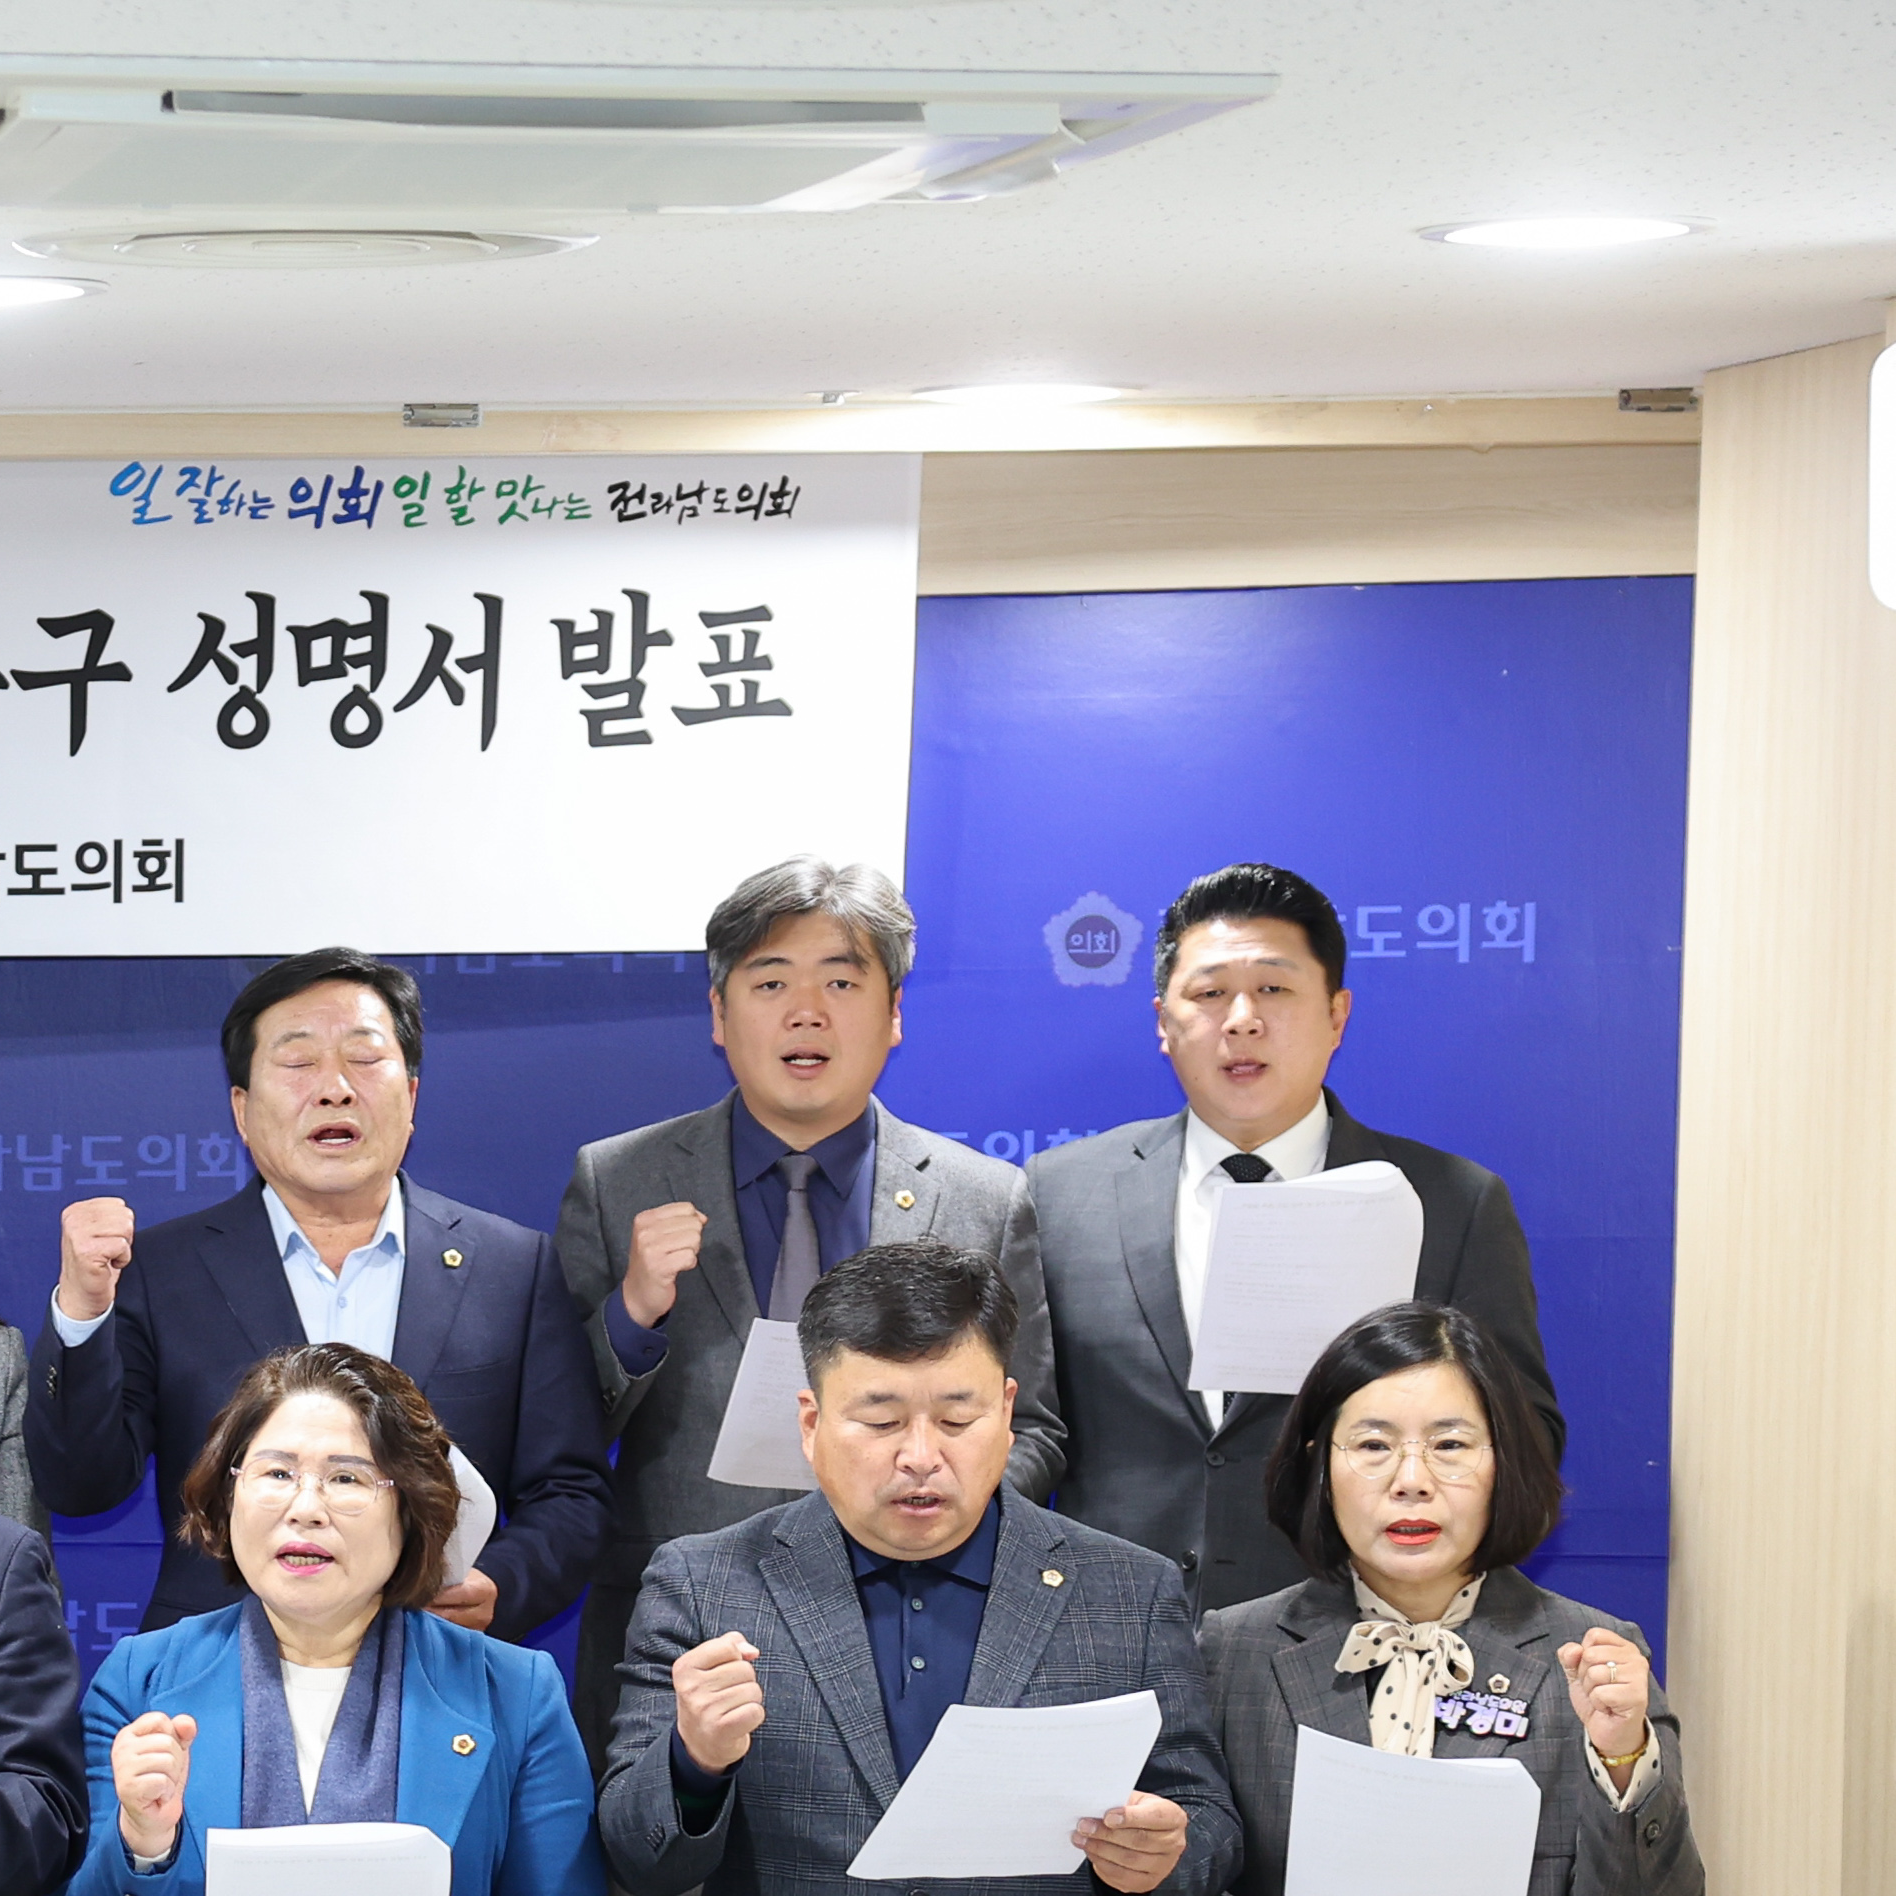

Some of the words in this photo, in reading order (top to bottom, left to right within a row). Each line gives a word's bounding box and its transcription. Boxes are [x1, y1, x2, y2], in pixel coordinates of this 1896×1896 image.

[176, 465, 276, 524] 잘하는
[288, 466, 385, 530] 의회
[607, 475, 802, 526] 전라남도의회
[166, 590, 506, 754] 성명서
[549, 588, 795, 750] 발표
[1068, 926, 1121, 955] 의회
